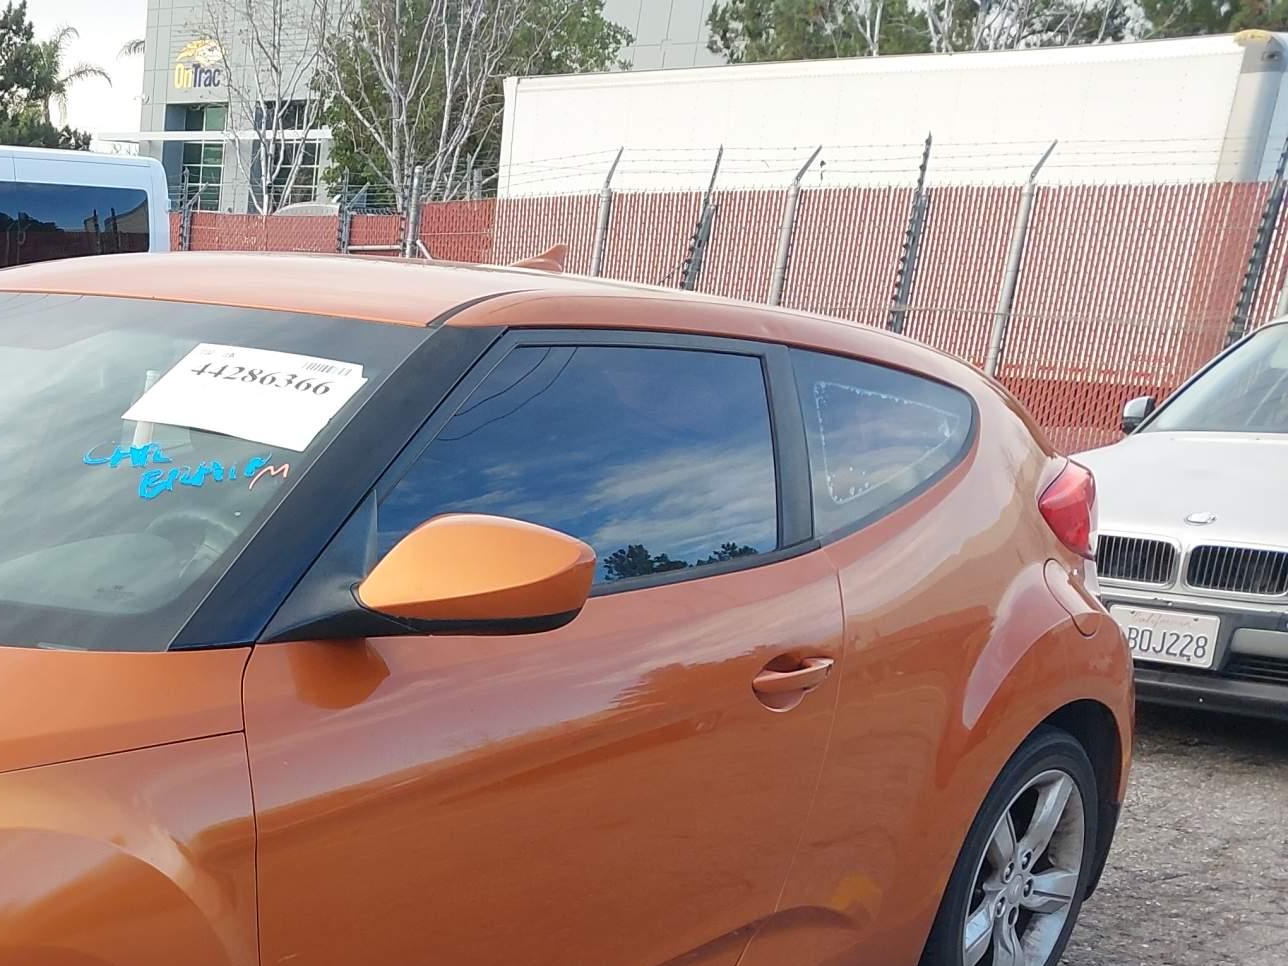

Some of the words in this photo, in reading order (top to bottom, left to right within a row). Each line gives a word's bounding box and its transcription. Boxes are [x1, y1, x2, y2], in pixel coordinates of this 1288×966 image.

[174, 63, 221, 88] OnTrac
[191, 362, 334, 395] 44286366
[1128, 627, 1209, 659] BOJ228
